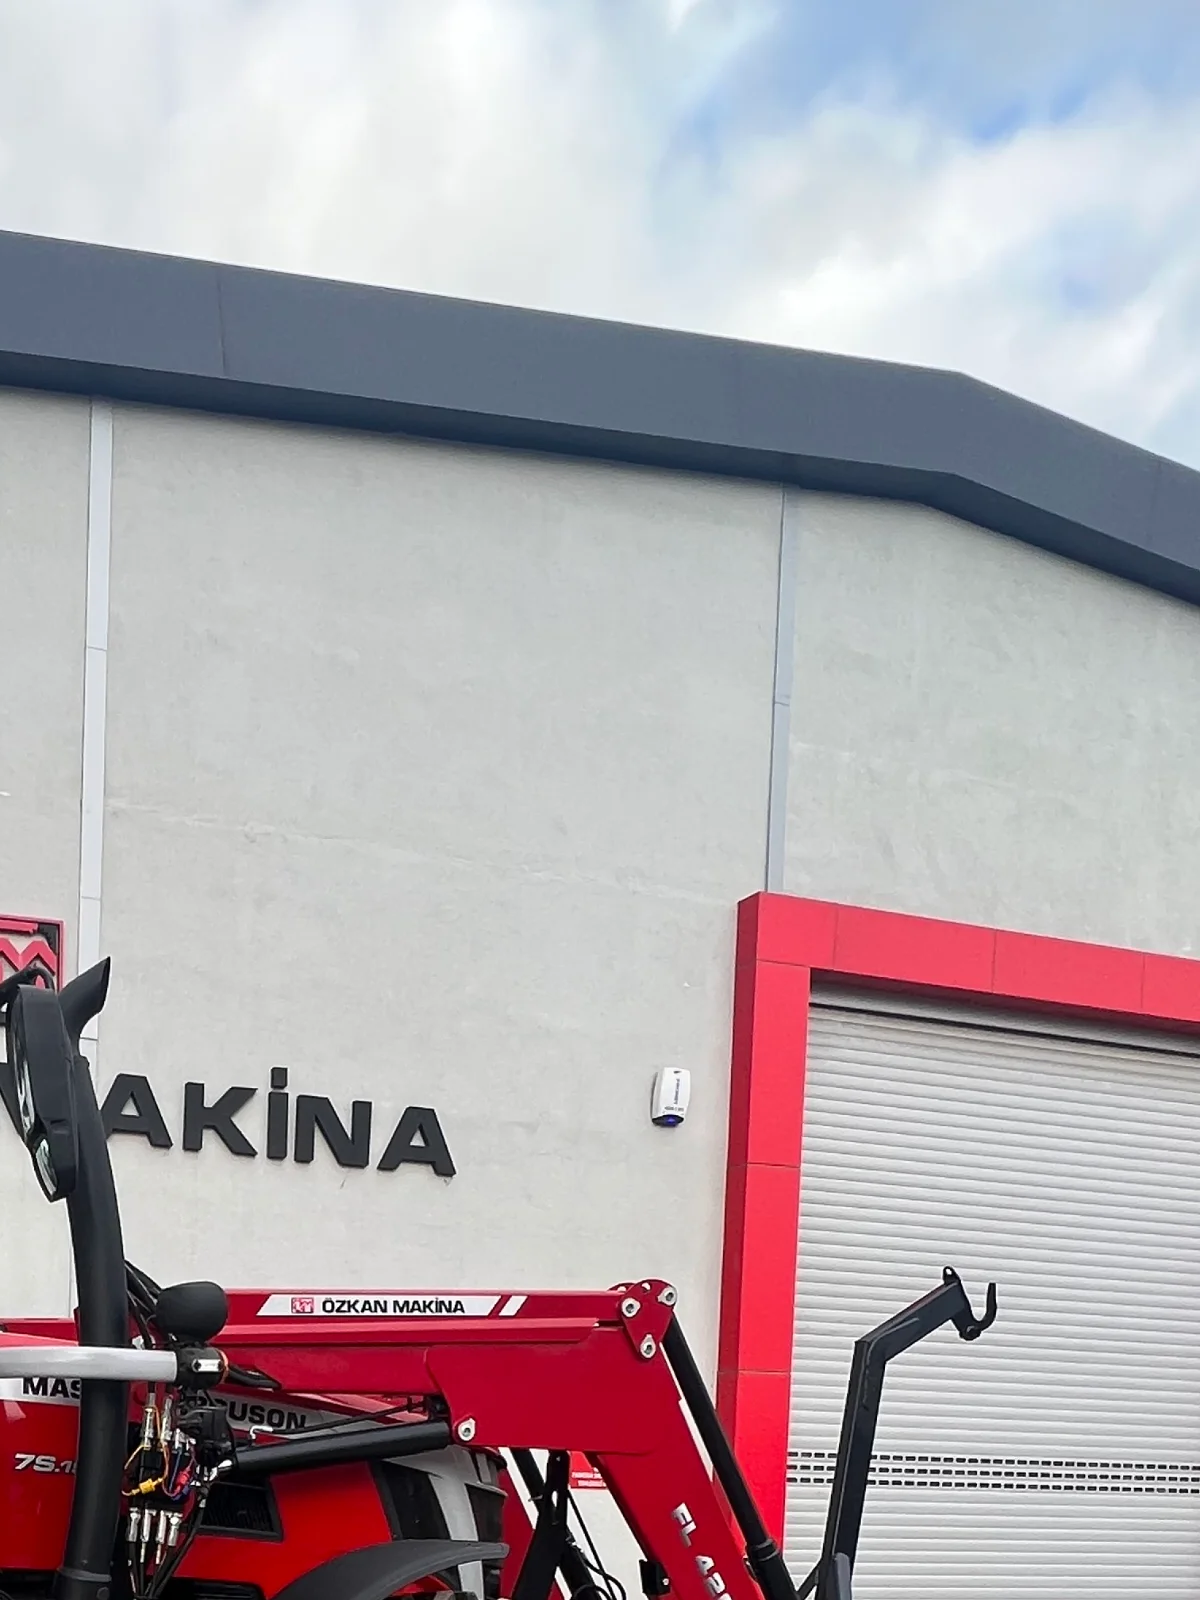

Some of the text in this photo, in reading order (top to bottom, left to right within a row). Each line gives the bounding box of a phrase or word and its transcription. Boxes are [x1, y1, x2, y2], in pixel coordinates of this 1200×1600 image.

[322, 1297, 466, 1314] ÖZKAN MAKİNA
[671, 1502, 697, 1548] FL
